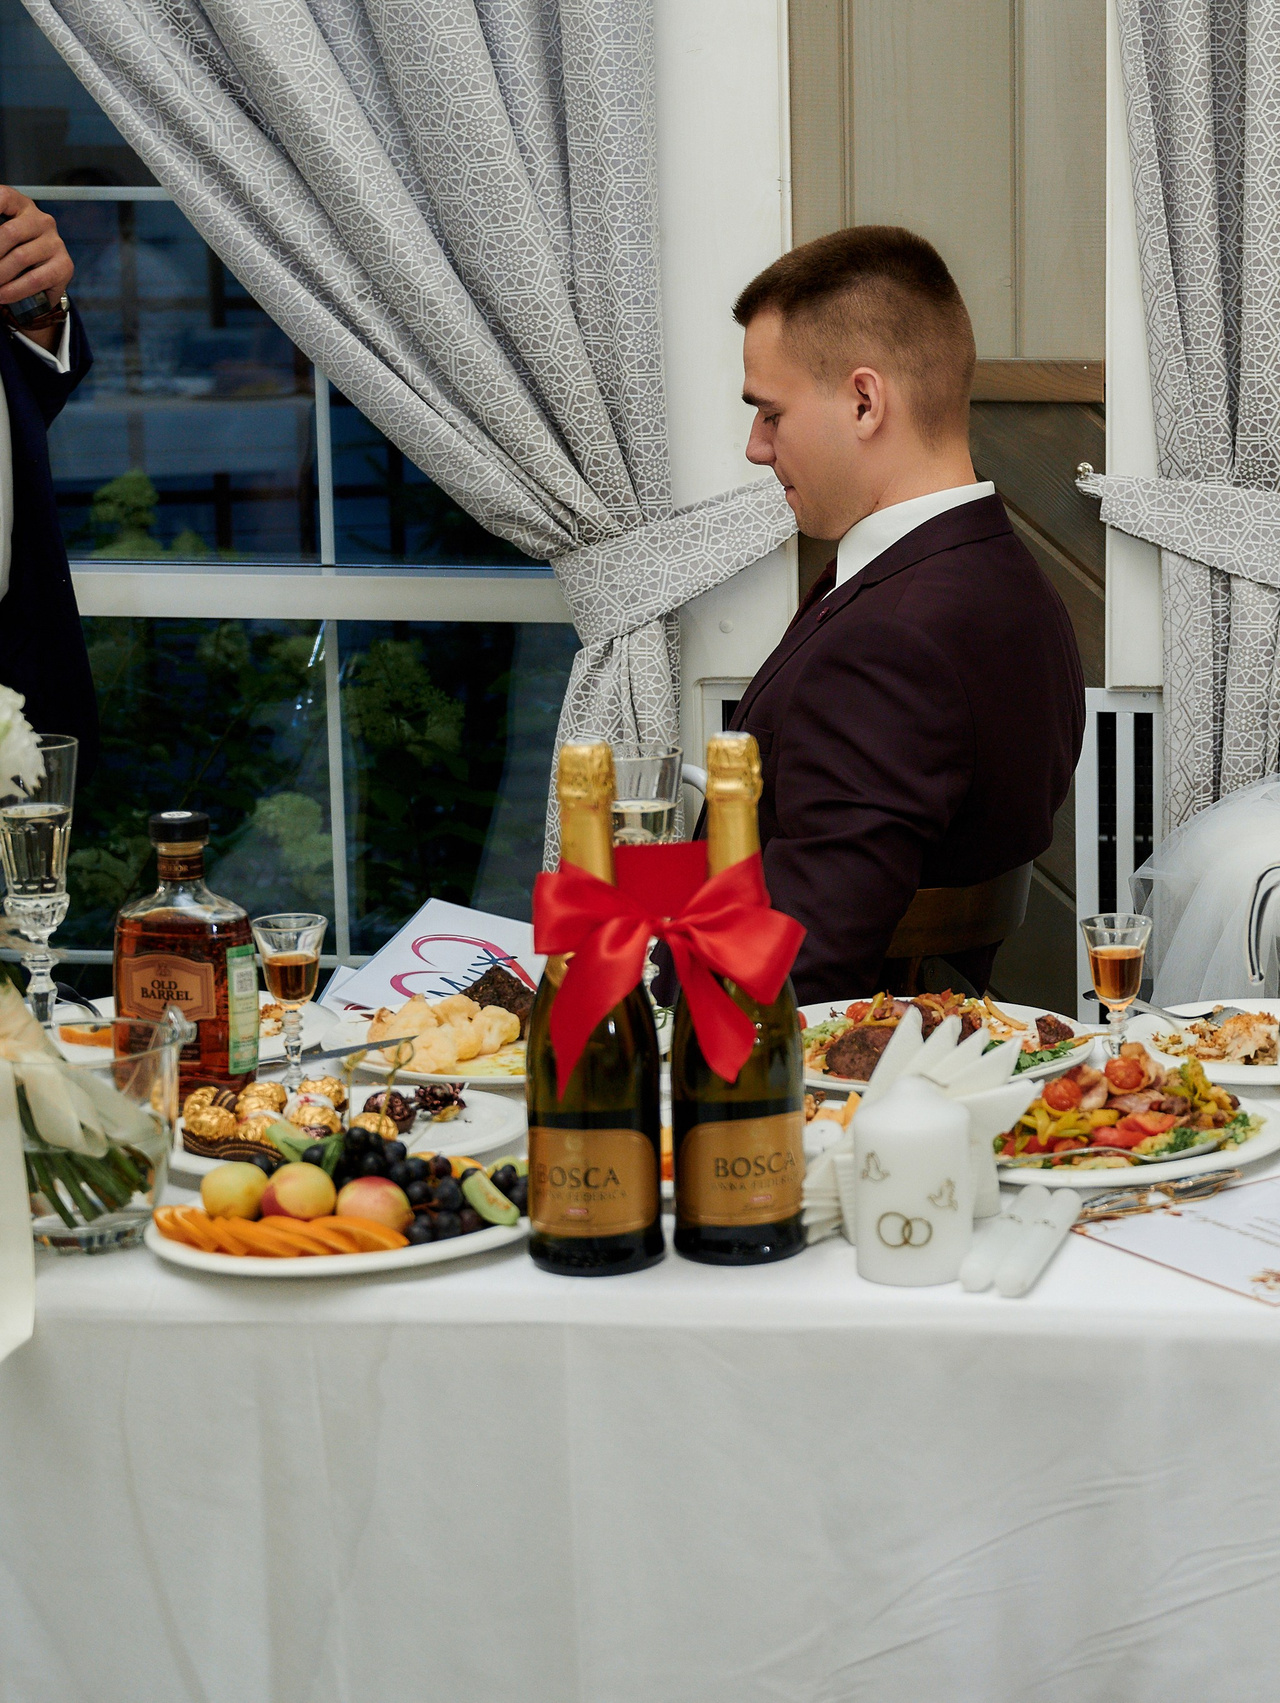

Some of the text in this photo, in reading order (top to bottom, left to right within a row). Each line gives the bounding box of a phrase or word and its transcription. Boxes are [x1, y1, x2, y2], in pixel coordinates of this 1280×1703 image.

[140, 986, 194, 1001] BARREL
[150, 979, 178, 990] OLD
[534, 1162, 621, 1189] BOSCA
[714, 1151, 796, 1179] BOSCA
